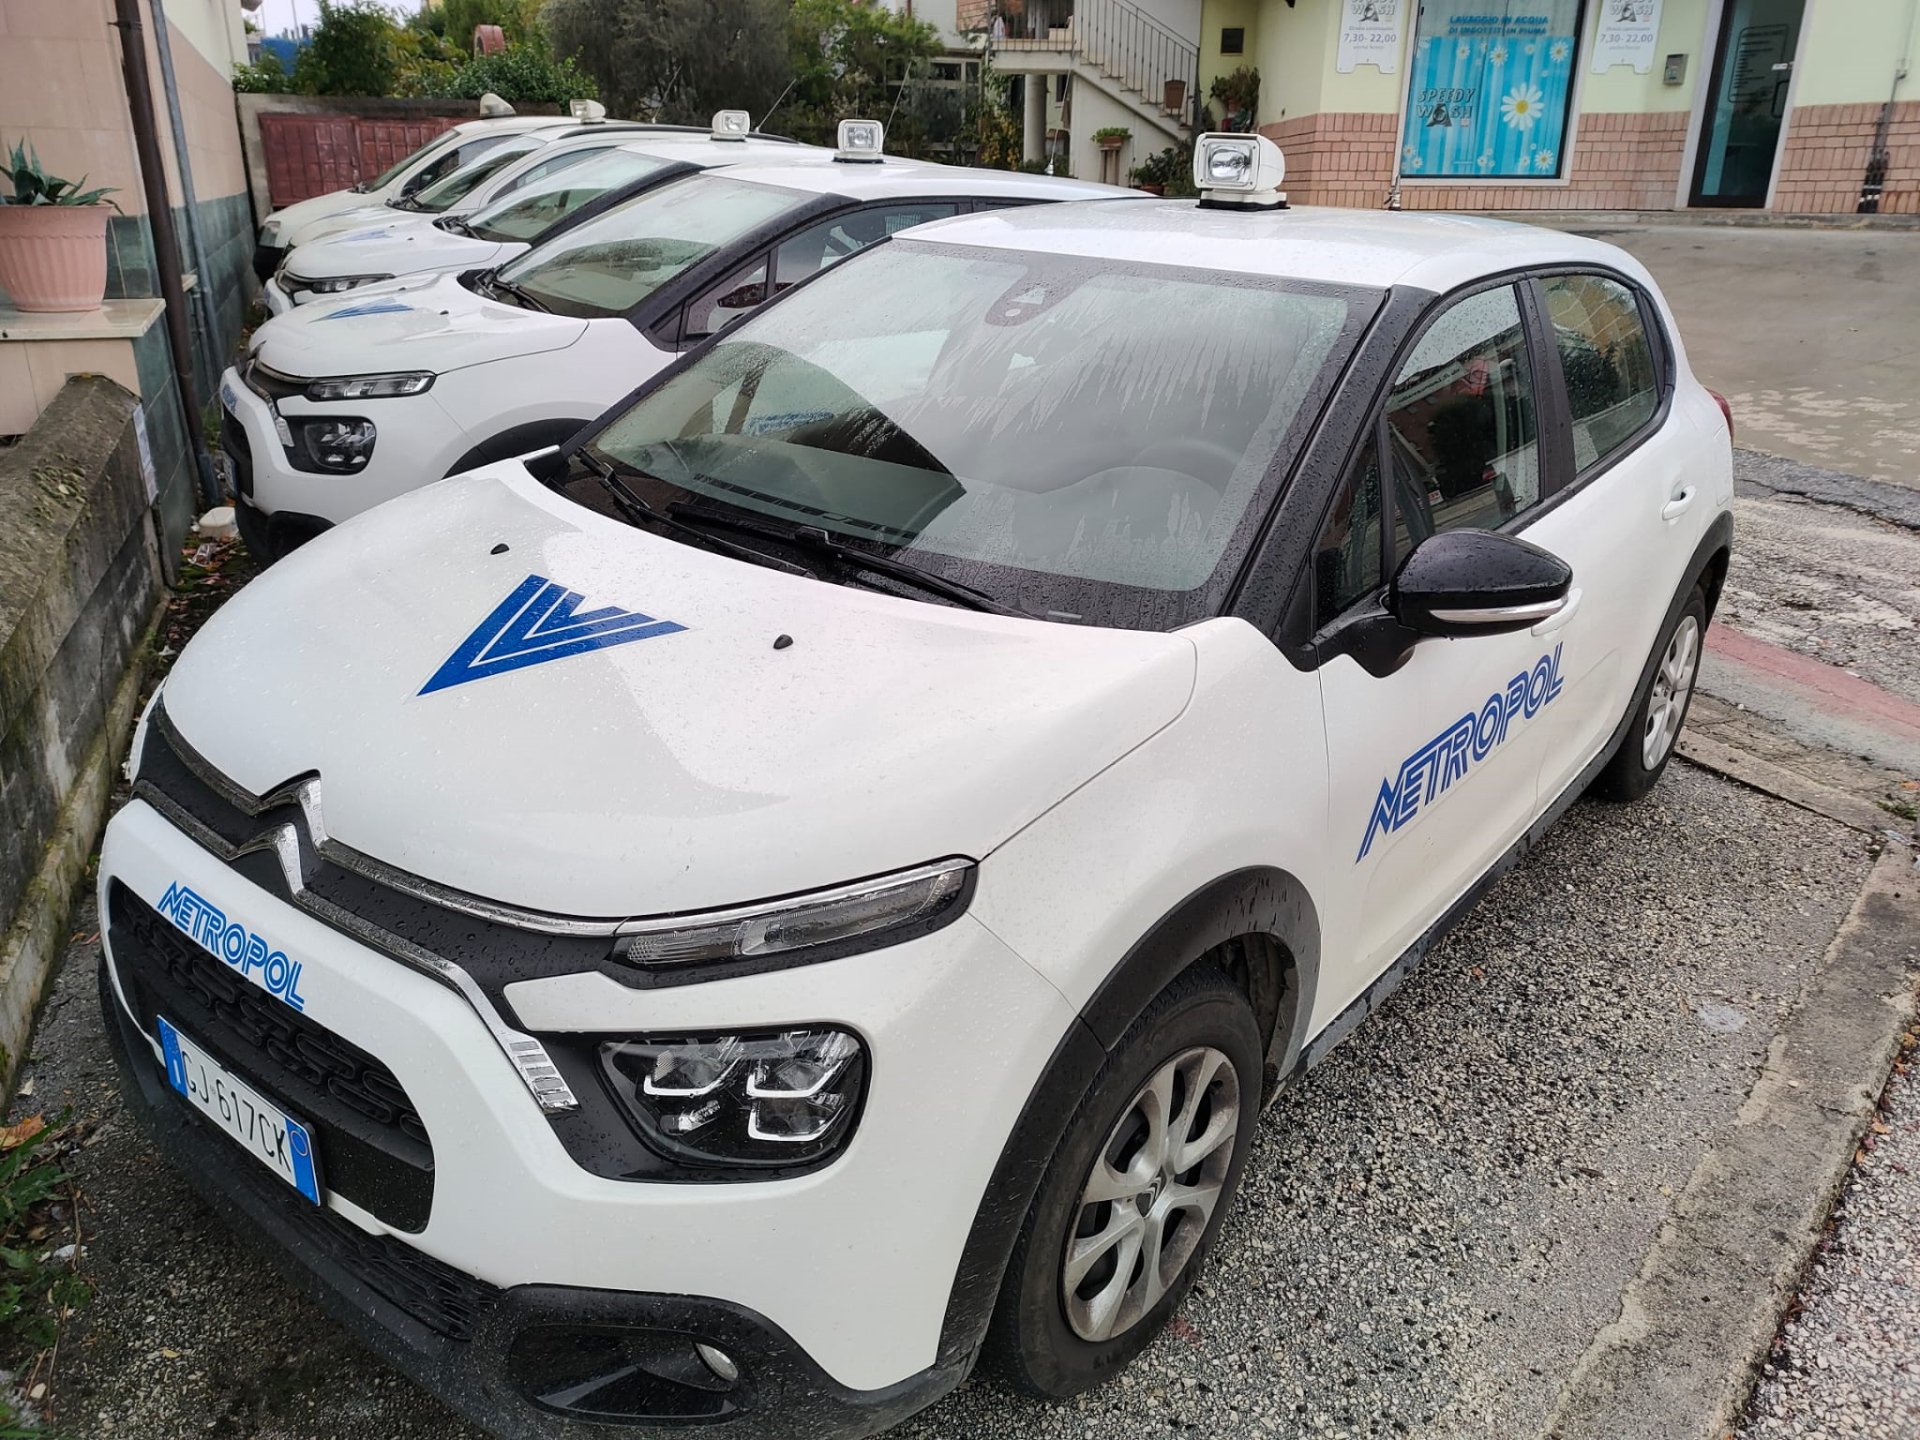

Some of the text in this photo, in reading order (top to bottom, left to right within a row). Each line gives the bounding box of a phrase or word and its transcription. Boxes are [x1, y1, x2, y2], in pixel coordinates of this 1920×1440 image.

[1449, 15, 1499, 25] LAVAGGIO
[1514, 15, 1549, 25] ACQUA
[1518, 27, 1547, 35] PIUMA
[1417, 88, 1477, 103] SPEEDY
[1416, 103, 1473, 127] WASH
[1355, 641, 1565, 865] METROPOL
[157, 880, 305, 1012] METROPOL
[215, 1078, 292, 1173] 617CK
